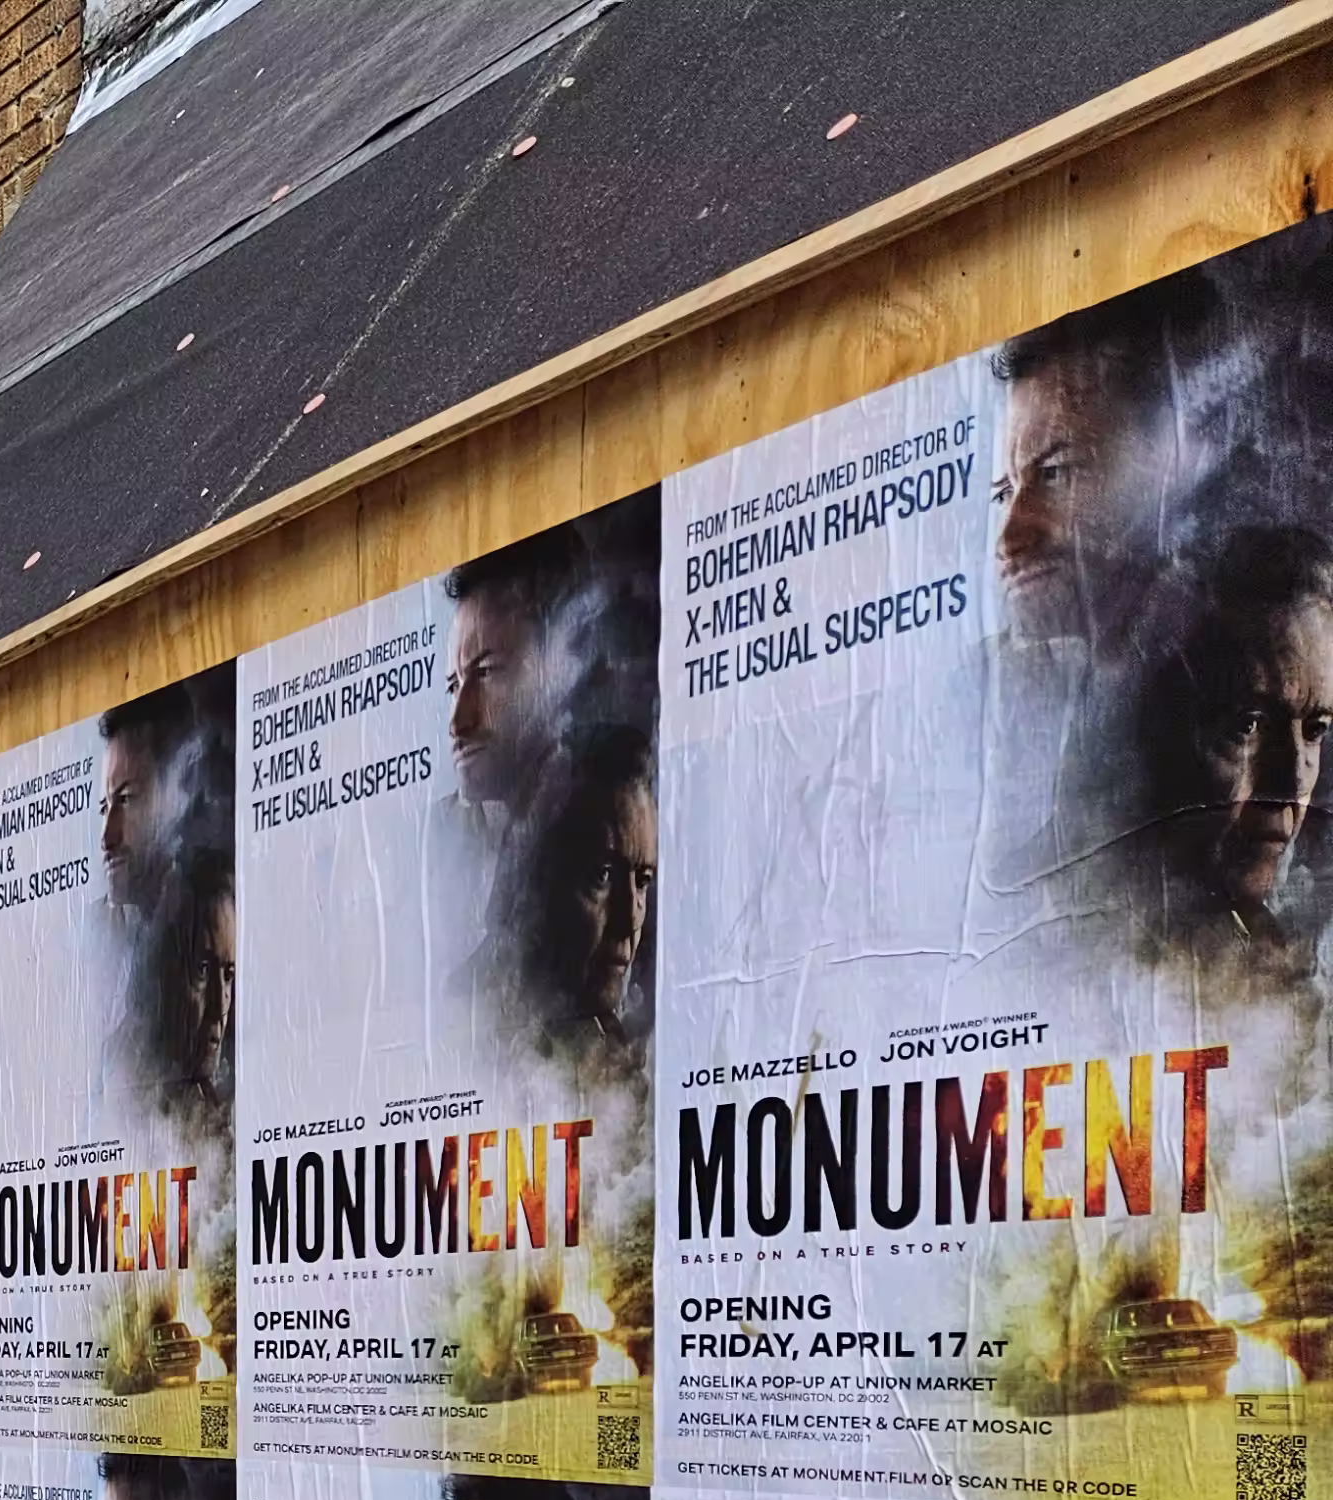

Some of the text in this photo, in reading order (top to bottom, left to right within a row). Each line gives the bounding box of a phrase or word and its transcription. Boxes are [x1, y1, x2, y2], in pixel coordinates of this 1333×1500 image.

[686, 413, 975, 547] FROM THE ACCLAIMED DIRECTOR OF
[686, 451, 974, 596] BOHEMIAN RHAPSODY
[684, 573, 792, 648] X-MEN &
[684, 569, 967, 699] THE USUAL SUSPECTS
[28, 854, 89, 902] SUSPECTS
[879, 1022, 1049, 1064] JON VOIGHT
[888, 1023, 940, 1039] ACADEMY
[992, 1010, 1037, 1025] WINNER
[681, 1047, 857, 1089] JOE MAZZELLO
[677, 1045, 1228, 1242] MONUMENT
[251, 1119, 592, 1267] MONUMENT
[680, 1240, 966, 1265] BASED ON A TRUE STORY
[253, 1307, 350, 1332] OPENING
[680, 1292, 831, 1323] OPENING
[680, 1330, 1011, 1362] FRIDAY, APRIL 17 AT
[253, 1372, 454, 1385] ANGELIKA POP-UP AT UNION MARKET
[678, 1374, 998, 1391] ANGELIKA POP-UP AT UNION MARKET
[677, 1411, 1052, 1435] ANGELIKA FILM CENTER & CAFE AT MOSAIC
[1237, 1402, 1256, 1417] R
[677, 1460, 704, 1475] GET
[707, 1462, 767, 1478] TICKETS
[770, 1465, 789, 1479] AT
[793, 1466, 926, 1486] MONUMENT.FILM
[957, 1474, 1007, 1490] SCAN
[1011, 1477, 1048, 1493] THE
[1052, 1478, 1077, 1495] QR
[1082, 1480, 1137, 1498] CODE
